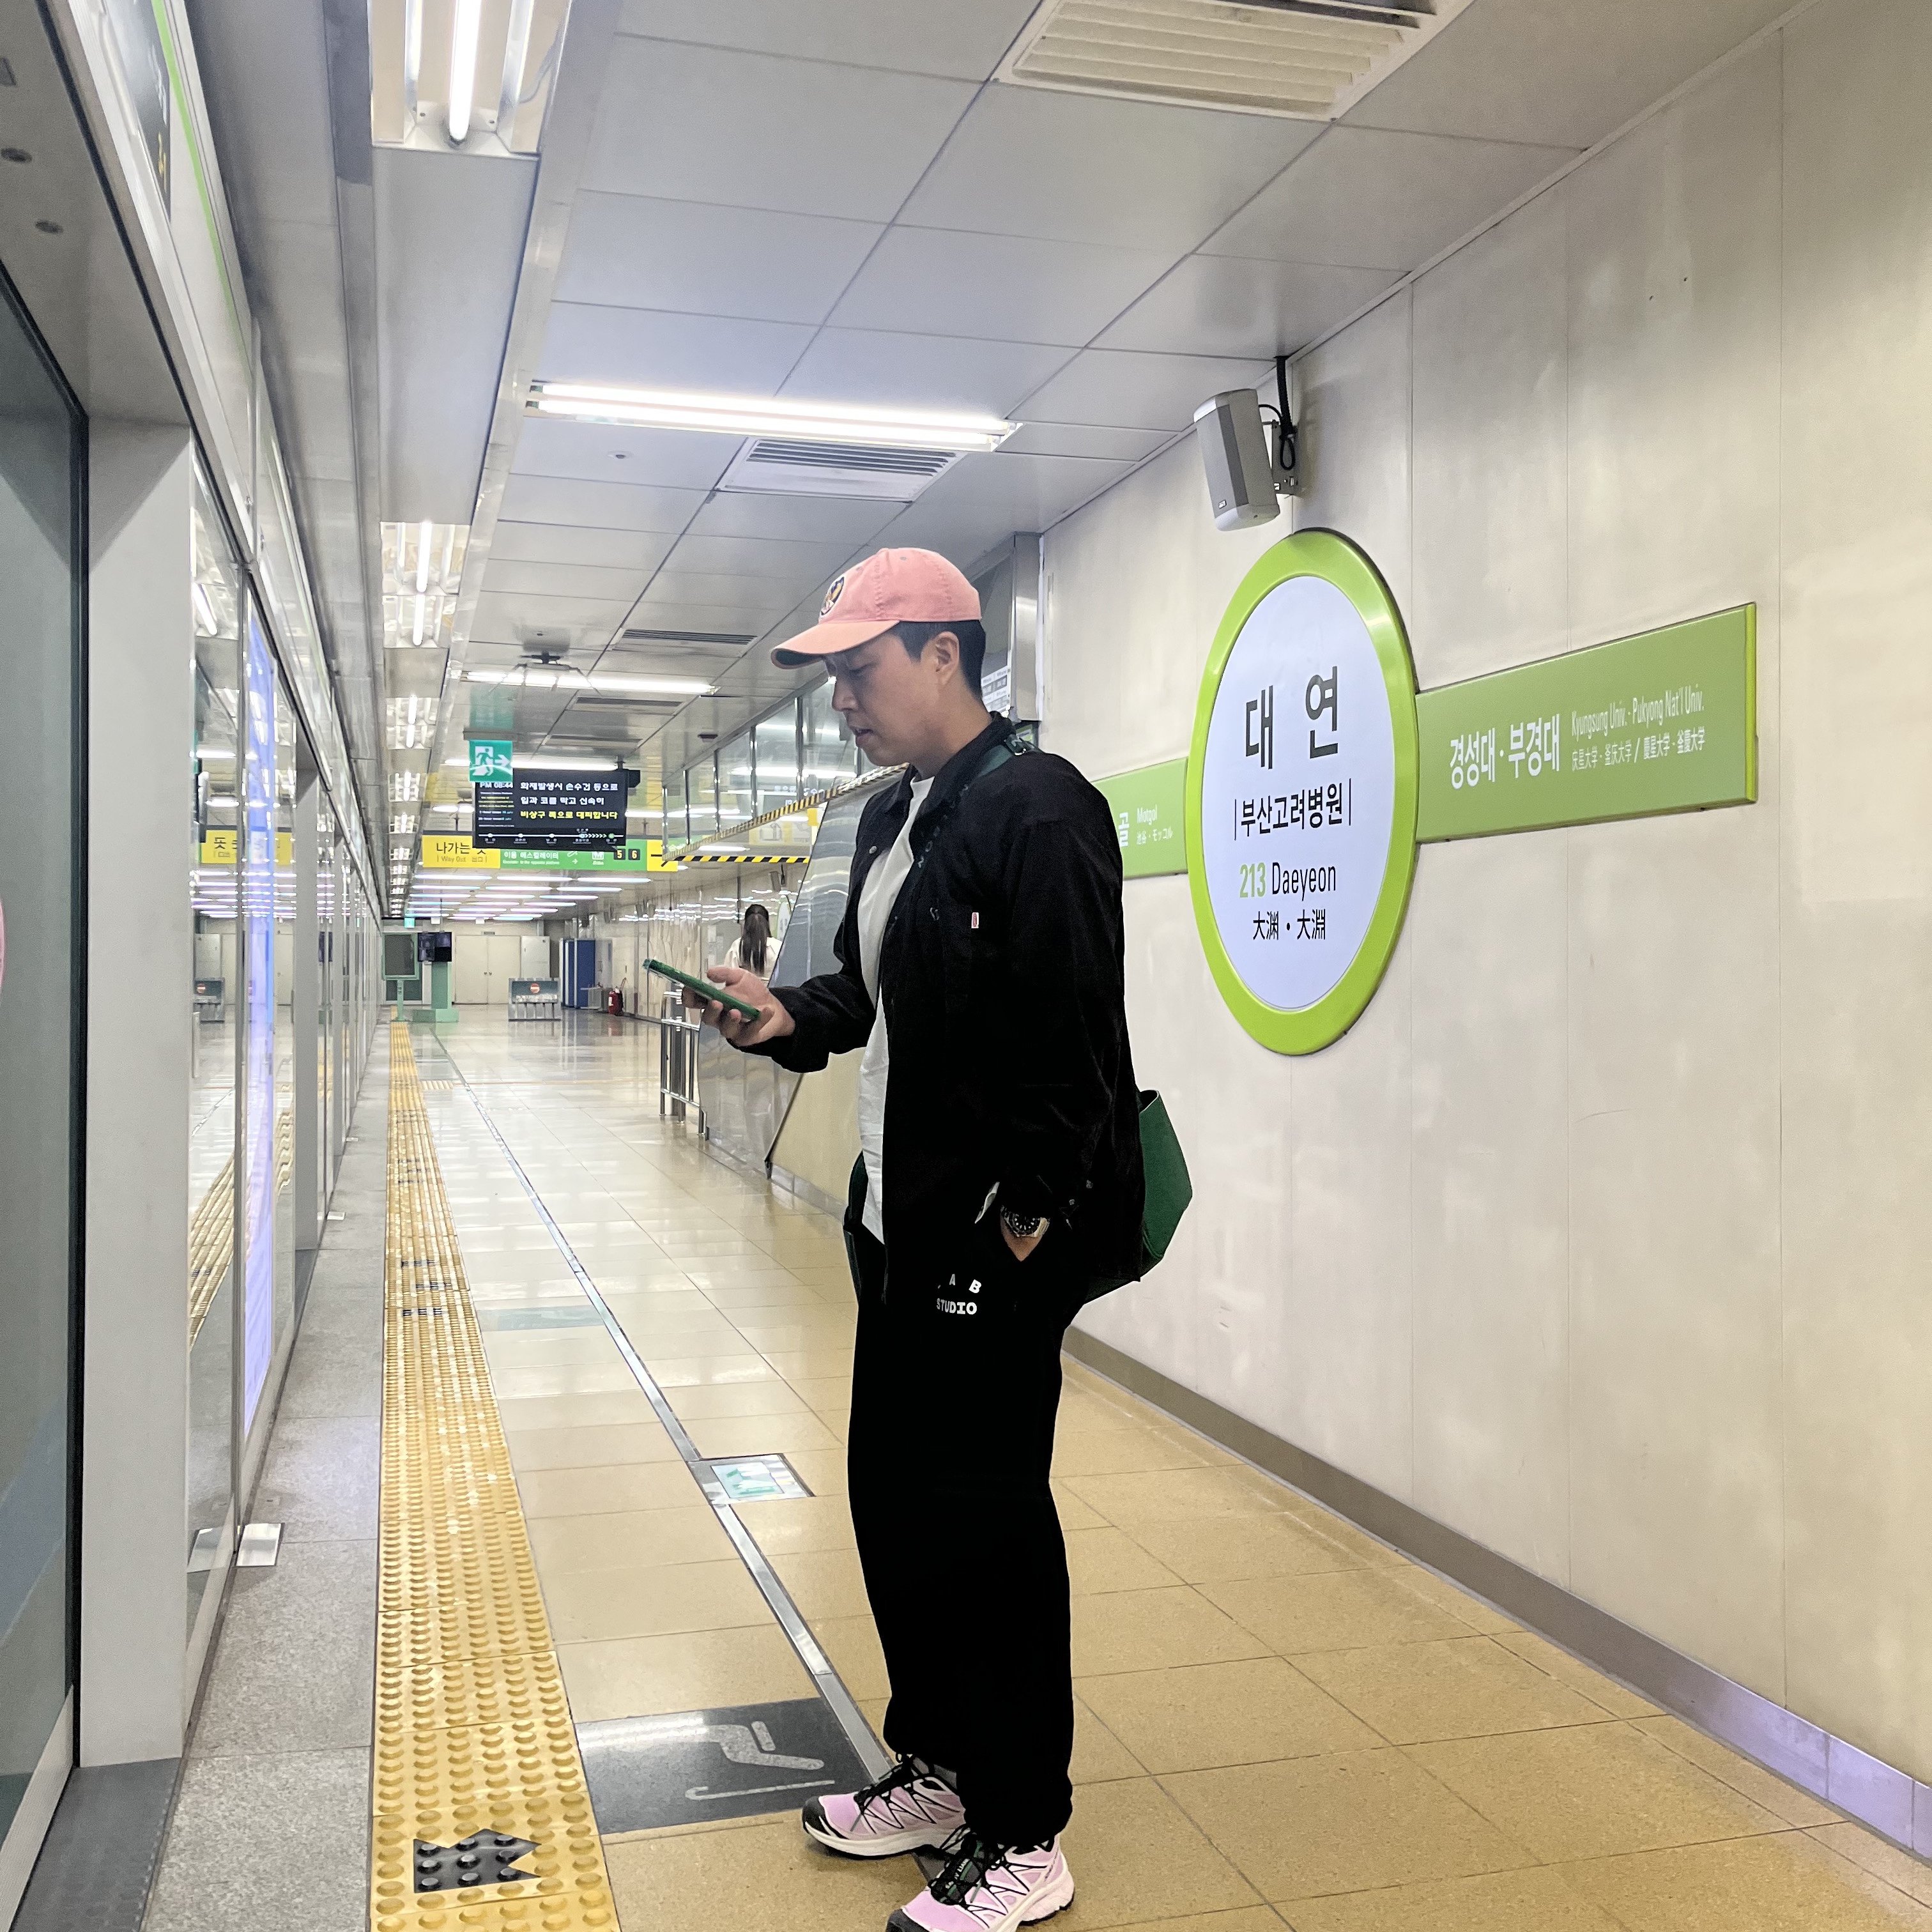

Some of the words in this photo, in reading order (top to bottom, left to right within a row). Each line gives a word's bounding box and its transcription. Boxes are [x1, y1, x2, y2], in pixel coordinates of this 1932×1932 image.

[1572, 710, 1608, 742] Kyungsung
[1610, 701, 1627, 729] Univ.
[1633, 696, 1663, 728] Pukyong
[1666, 686, 1683, 717] Nat'l
[1685, 683, 1705, 714] Univ.
[521, 782, 562, 790] 화재발생시
[565, 783, 590, 791] 손수건
[594, 783, 618, 791] 등으로
[521, 796, 537, 804] 입과
[521, 811, 545, 819] 비상구
[1137, 804, 1158, 825] Motgol
[1241, 783, 1342, 836] 부산고려병원
[1118, 812, 1130, 847] 골
[436, 841, 471, 854] 나가는
[617, 850, 622, 859] 5
[632, 850, 637, 859] 6
[520, 852, 559, 860] 에스컬레이터
[1239, 862, 1266, 898] 213
[1272, 862, 1336, 901] Daeyeon
[937, 1298, 977, 1315] STUDIO
